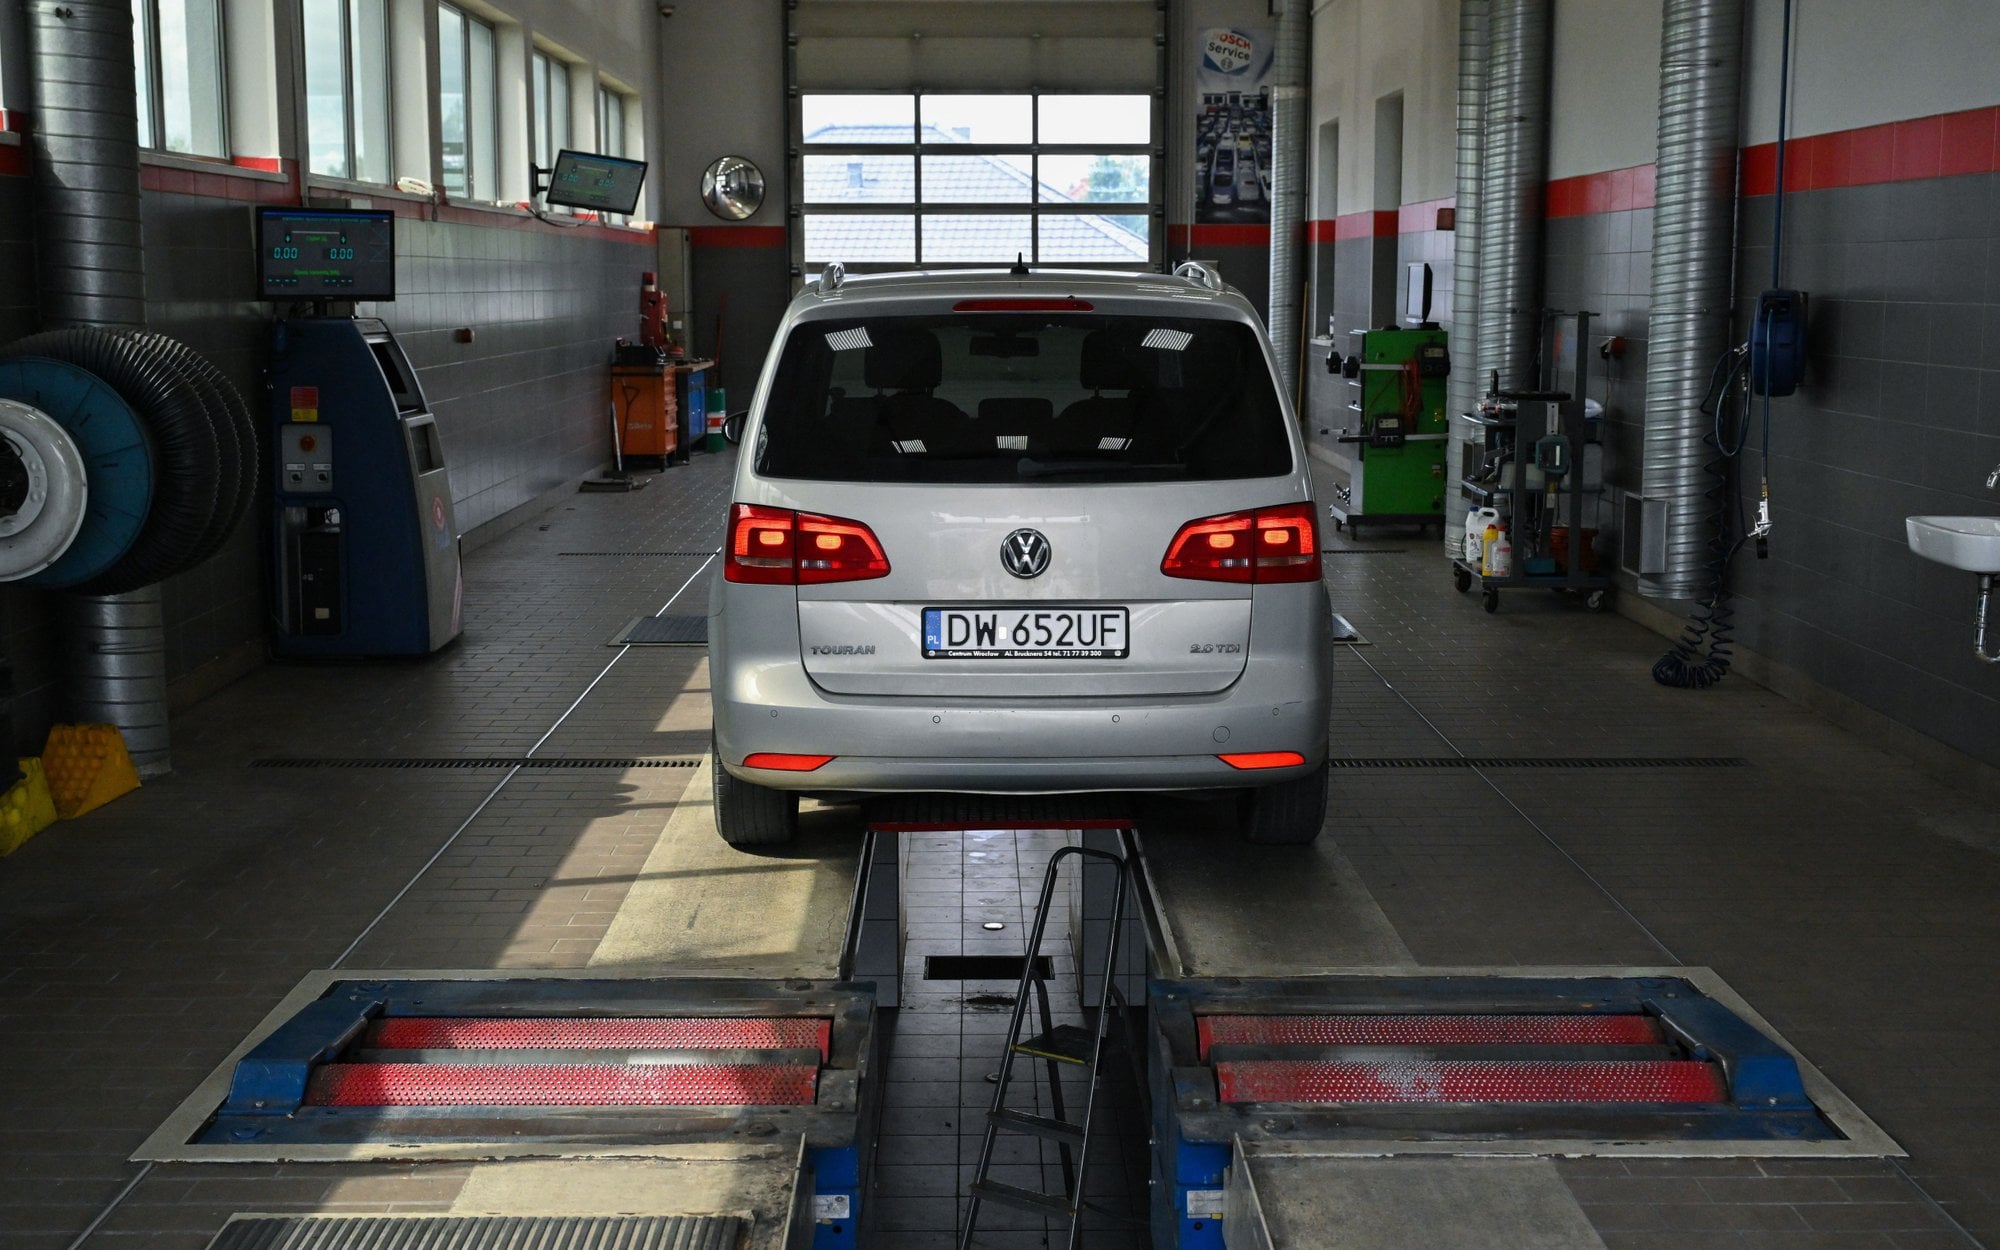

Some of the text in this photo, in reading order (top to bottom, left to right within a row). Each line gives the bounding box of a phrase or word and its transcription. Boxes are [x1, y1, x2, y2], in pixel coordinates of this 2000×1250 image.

[1213, 32, 1251, 51] OSCH
[1208, 42, 1250, 61] Service
[273, 247, 353, 260] 0.00 0.00
[948, 613, 1120, 647] DW 652UF
[927, 635, 939, 645] PL
[810, 645, 876, 655] TOURAN
[1190, 643, 1241, 654] 2.0 TDI
